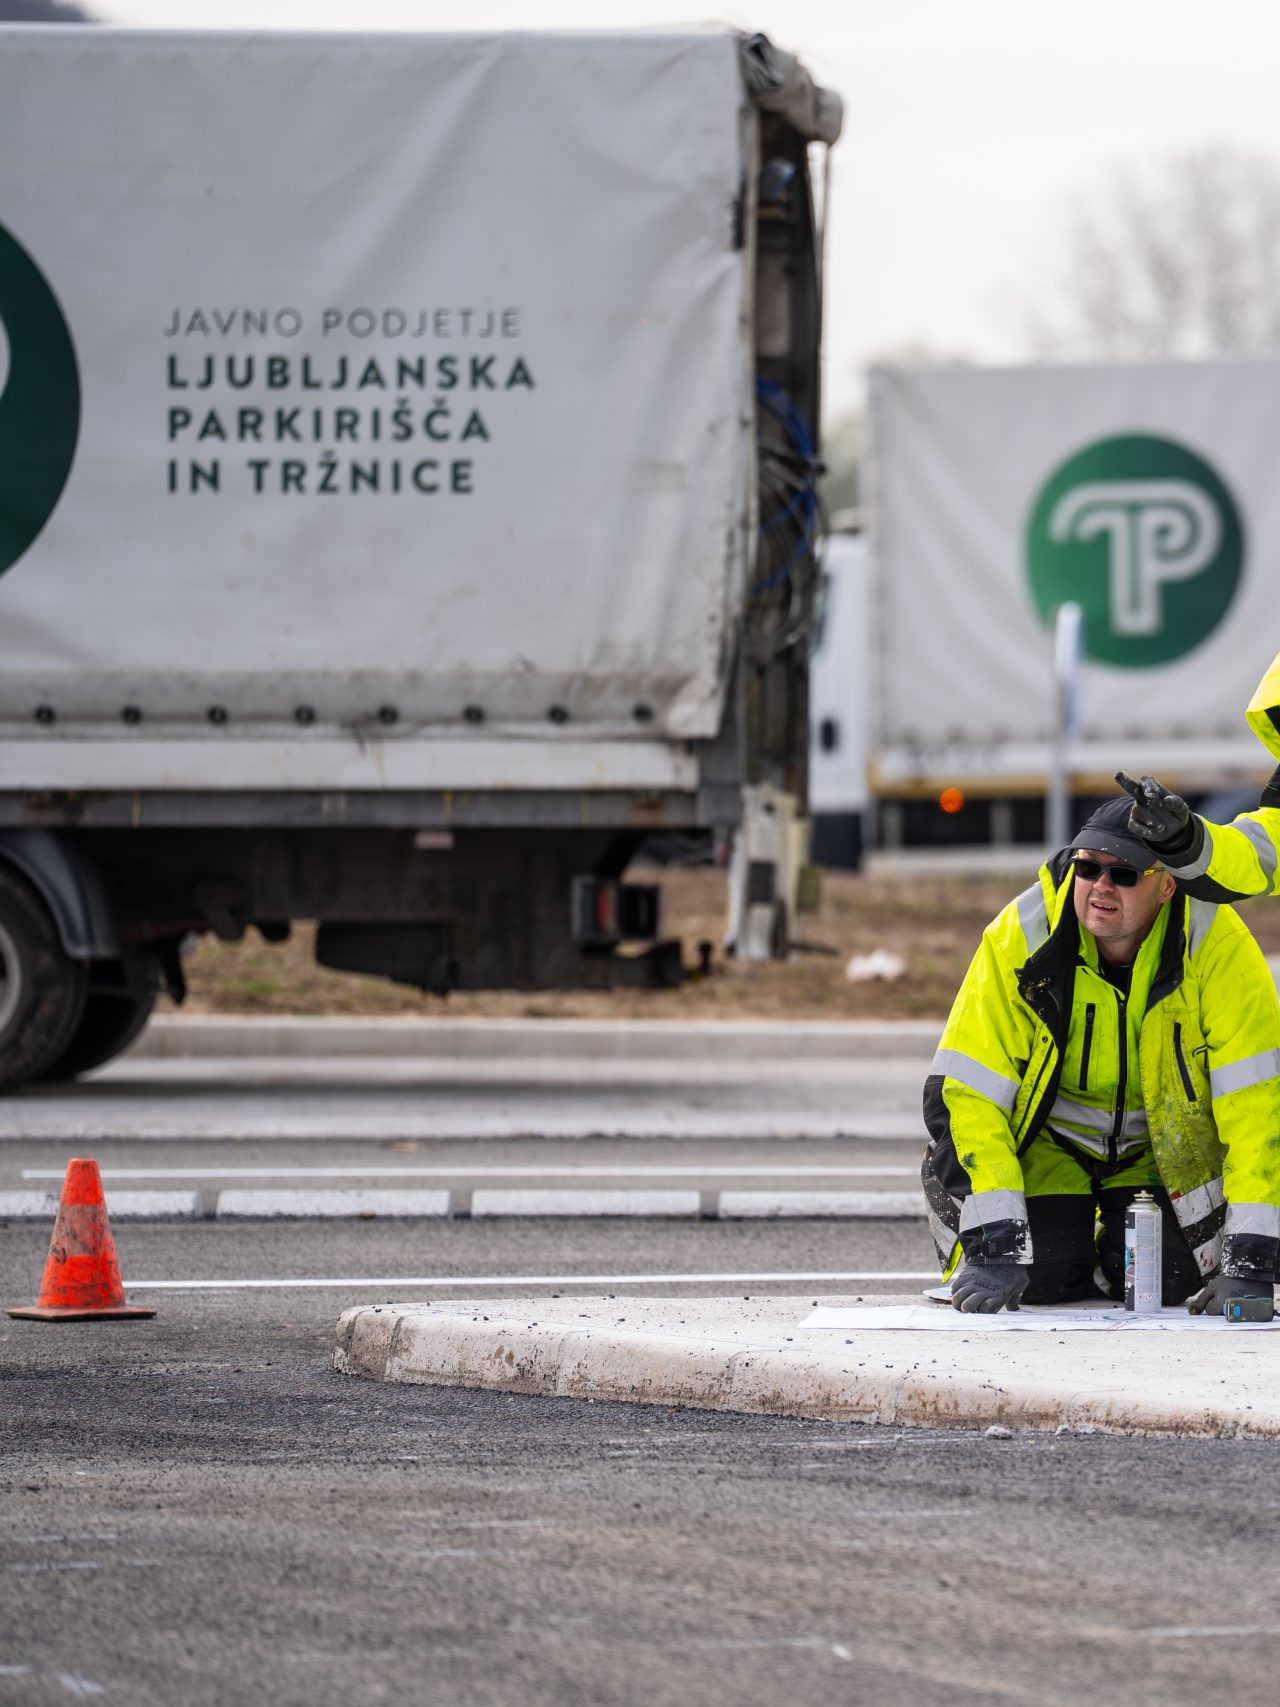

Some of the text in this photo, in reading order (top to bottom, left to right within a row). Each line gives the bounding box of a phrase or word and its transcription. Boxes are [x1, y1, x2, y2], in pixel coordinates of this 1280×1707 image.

[164, 307, 520, 339] JAVNO PODJETJE
[166, 353, 536, 391] LJUBLJANSKA
[167, 397, 491, 443] PARKIRIŠČA
[167, 449, 475, 495] IN TRŽNICE
